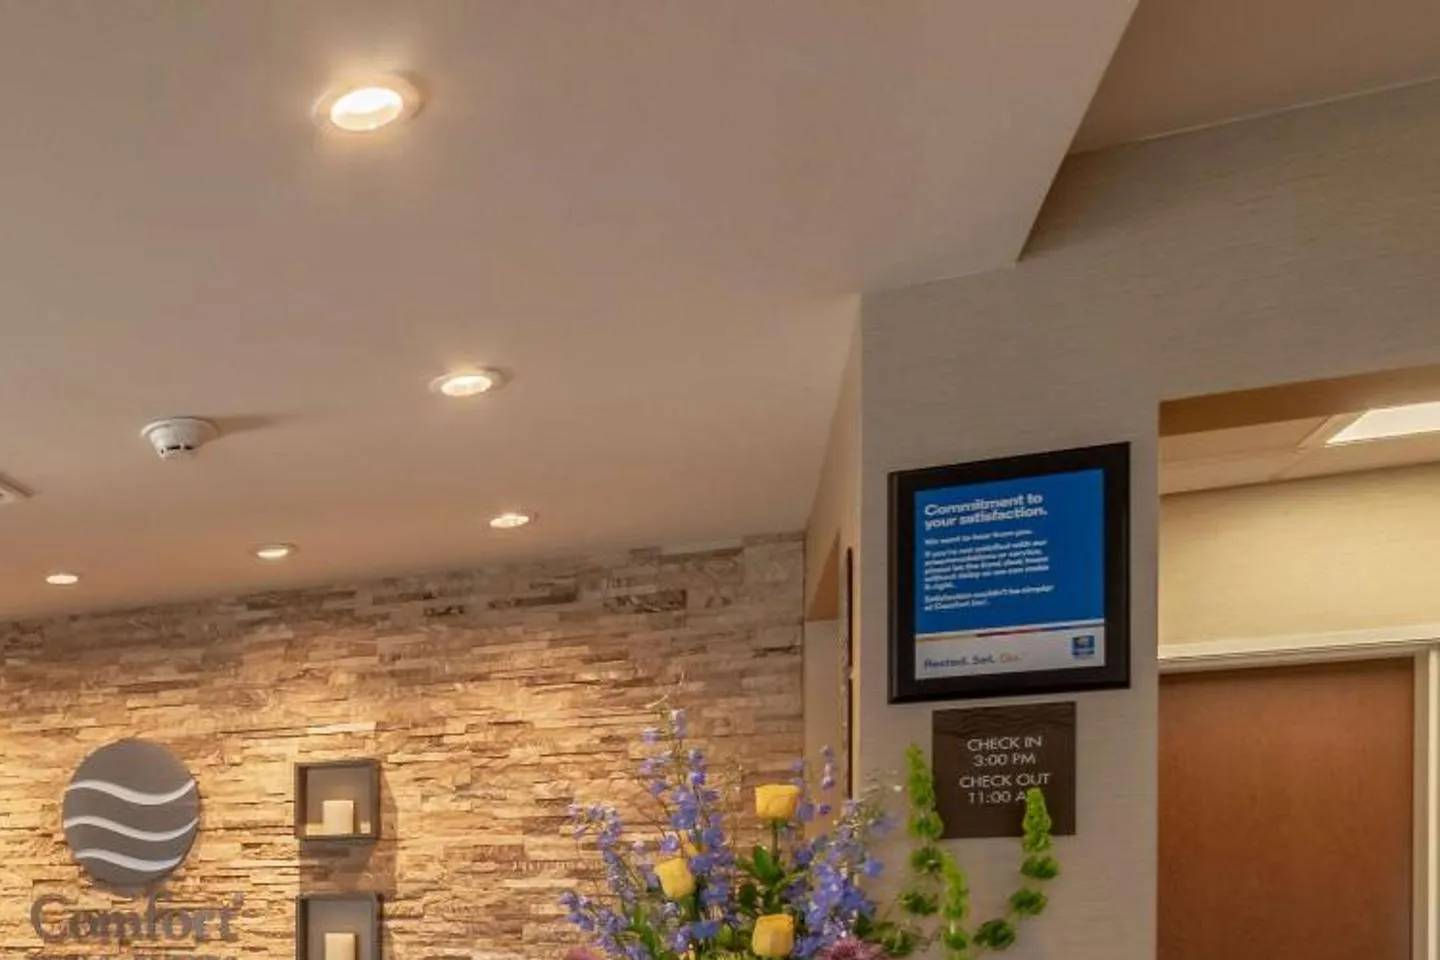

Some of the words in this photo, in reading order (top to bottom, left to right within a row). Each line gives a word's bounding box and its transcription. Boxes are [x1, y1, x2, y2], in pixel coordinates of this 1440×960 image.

[924, 495, 1024, 515] Commitment
[1026, 493, 1043, 505] to
[924, 519, 957, 530] your
[959, 507, 1048, 524] satisfaction.
[967, 736, 1020, 751] CHECK
[1024, 736, 1043, 748] IN
[973, 754, 1008, 767] 3:00
[1012, 753, 1036, 765] PM
[960, 774, 1013, 788] CHECK
[1016, 773, 1051, 786] OUT
[968, 791, 1010, 804] 11:00
[1014, 791, 1030, 802] A
[30, 892, 240, 943] Comfort
